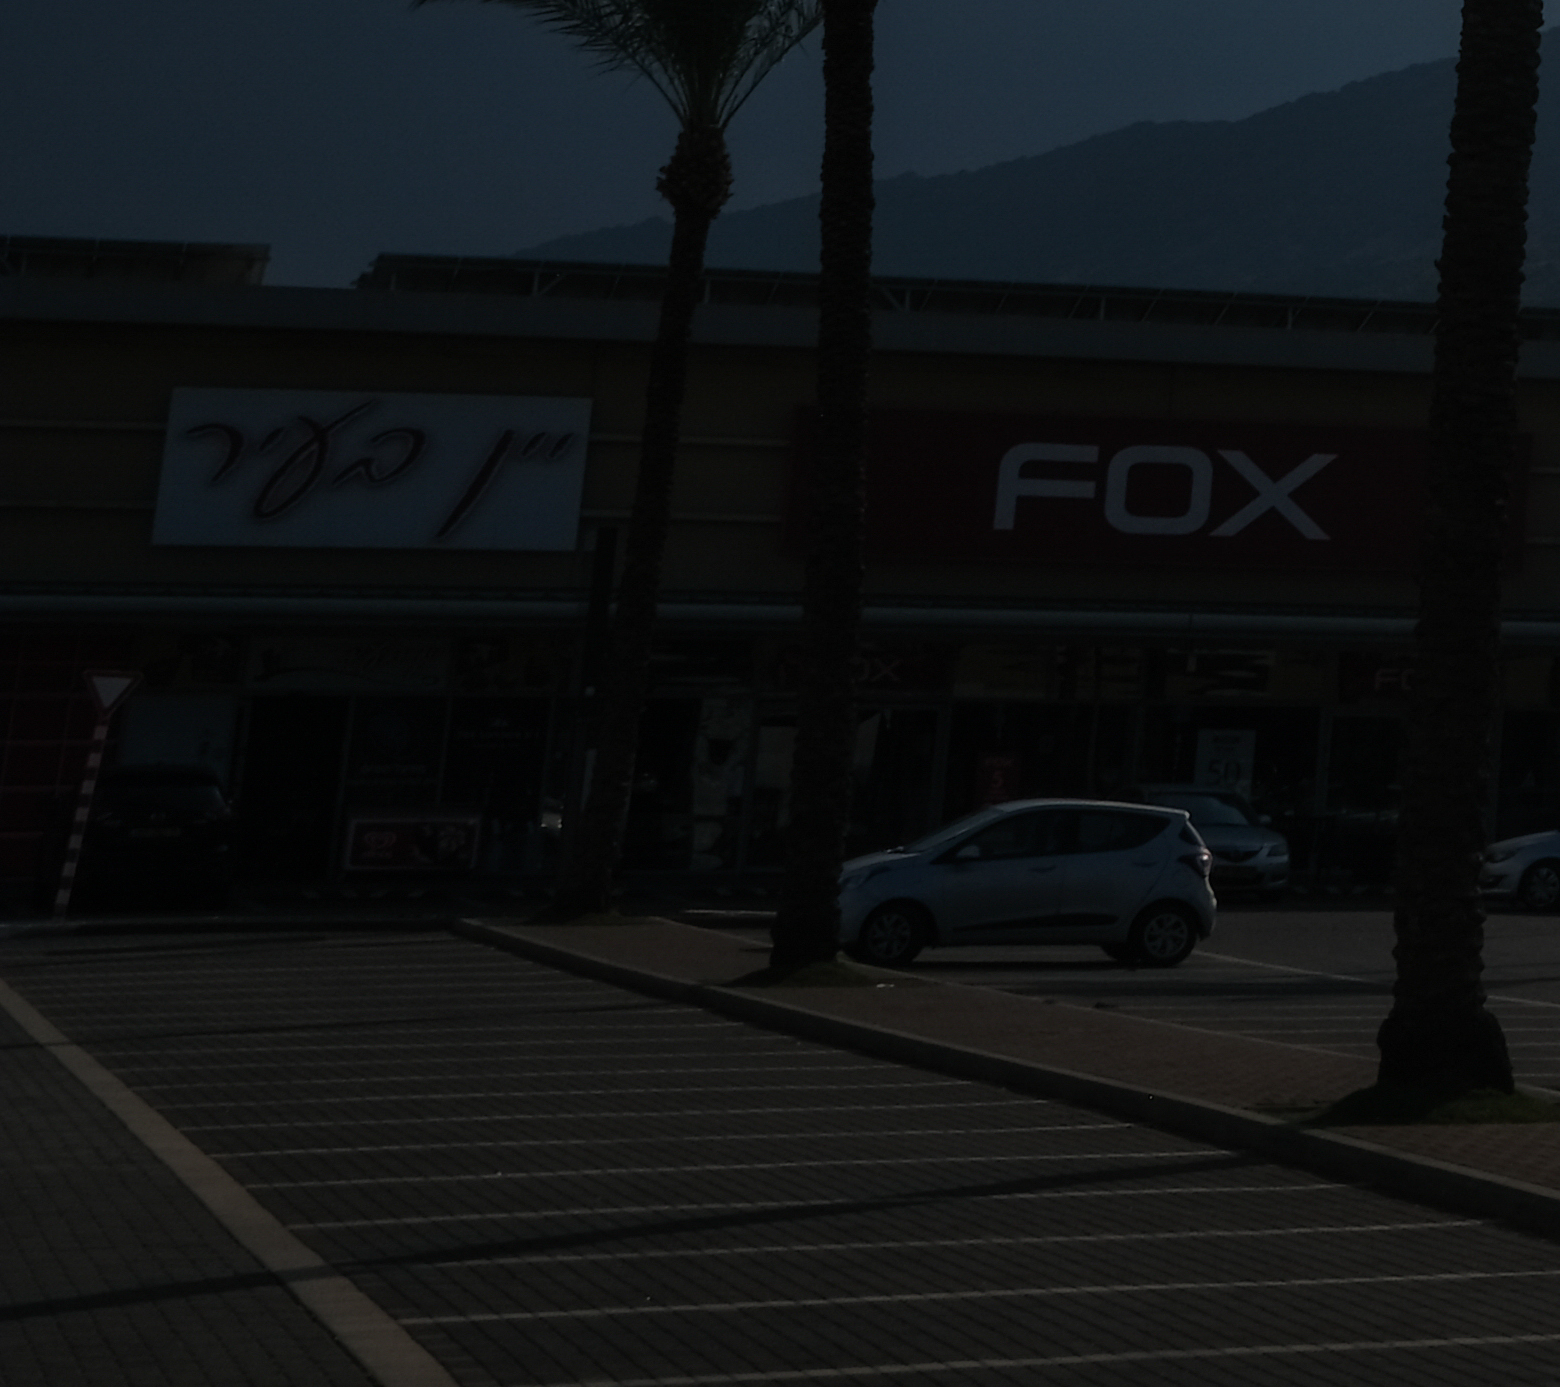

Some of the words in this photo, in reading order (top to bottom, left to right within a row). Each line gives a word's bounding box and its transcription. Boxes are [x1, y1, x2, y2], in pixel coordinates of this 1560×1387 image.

[187, 400, 426, 522] בעיר
[436, 428, 576, 540] יין
[992, 442, 1339, 541] FOX
